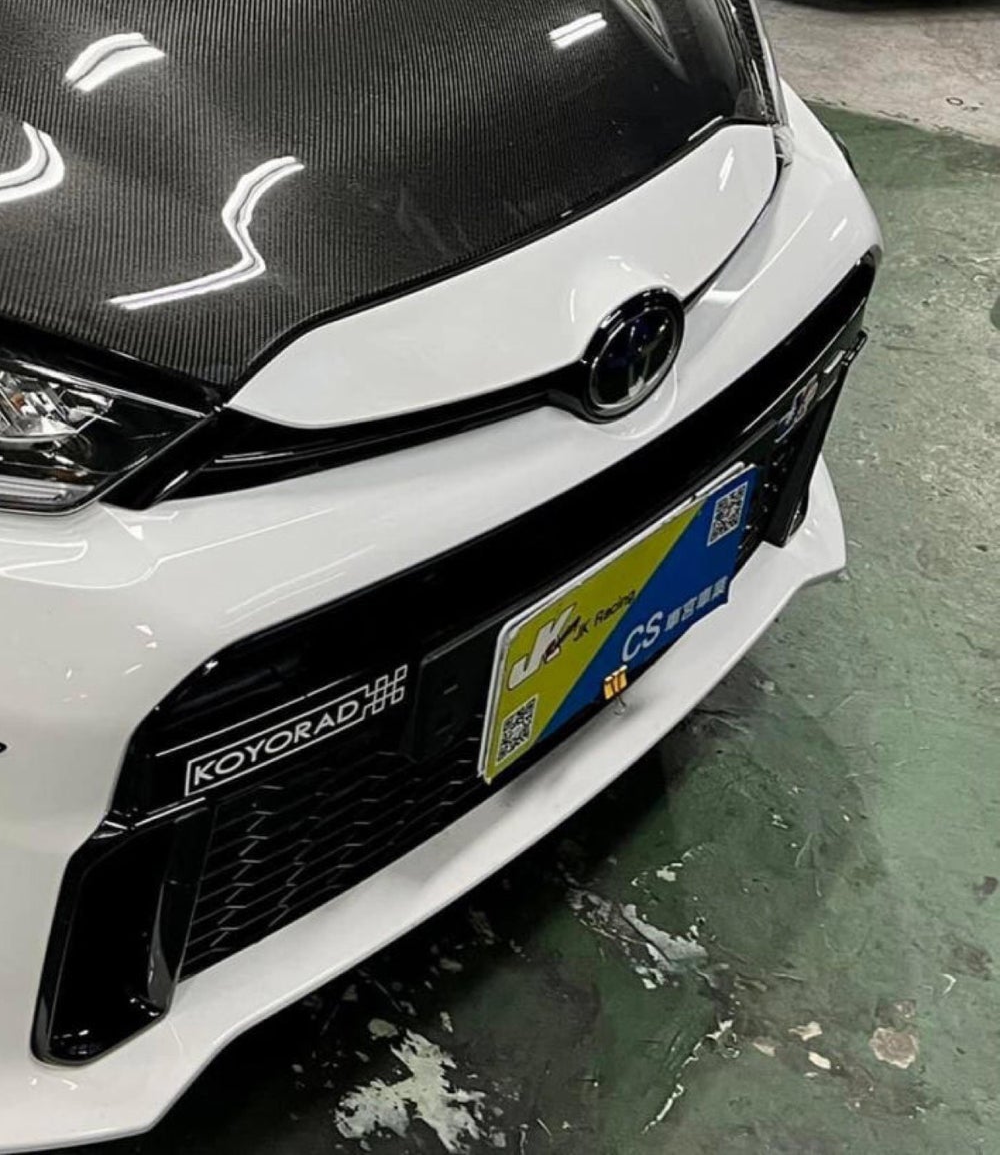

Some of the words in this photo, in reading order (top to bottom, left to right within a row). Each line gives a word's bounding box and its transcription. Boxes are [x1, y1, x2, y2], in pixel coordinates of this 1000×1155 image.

[594, 589, 636, 628] Racing
[621, 610, 664, 663] CS
[193, 699, 360, 786] KOYORAD
